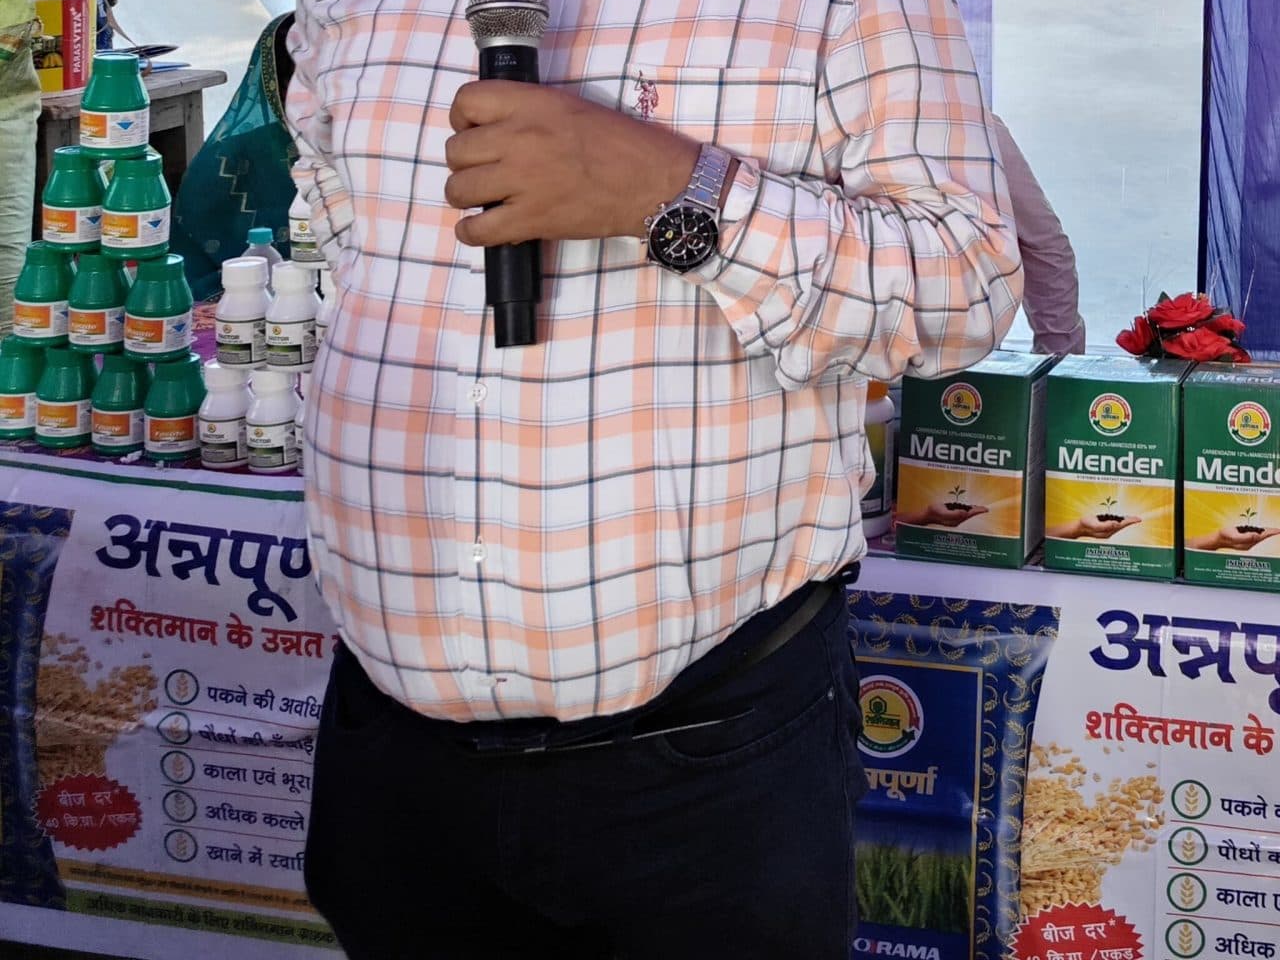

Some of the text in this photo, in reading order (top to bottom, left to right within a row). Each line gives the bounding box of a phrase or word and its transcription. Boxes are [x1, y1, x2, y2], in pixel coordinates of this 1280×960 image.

[910, 433, 1012, 466] Mender
[1058, 446, 1163, 475] Mender
[90, 599, 324, 658] शक्तिमान के उन्नत
[207, 685, 249, 707] पकने
[253, 689, 274, 711] की
[1086, 702, 1233, 752] शक्तिमान
[1243, 713, 1274, 755] के
[204, 763, 310, 793] काला एवं भूरा
[57, 792, 85, 808] बीज
[1221, 796, 1268, 820] पकने
[205, 803, 304, 830] अधिक कल्ले
[207, 844, 263, 866] खाने में
[1218, 840, 1260, 863] पौधों
[1216, 886, 1266, 909] काला
[1041, 922, 1075, 943] बीज
[1215, 933, 1275, 959] अधिक
